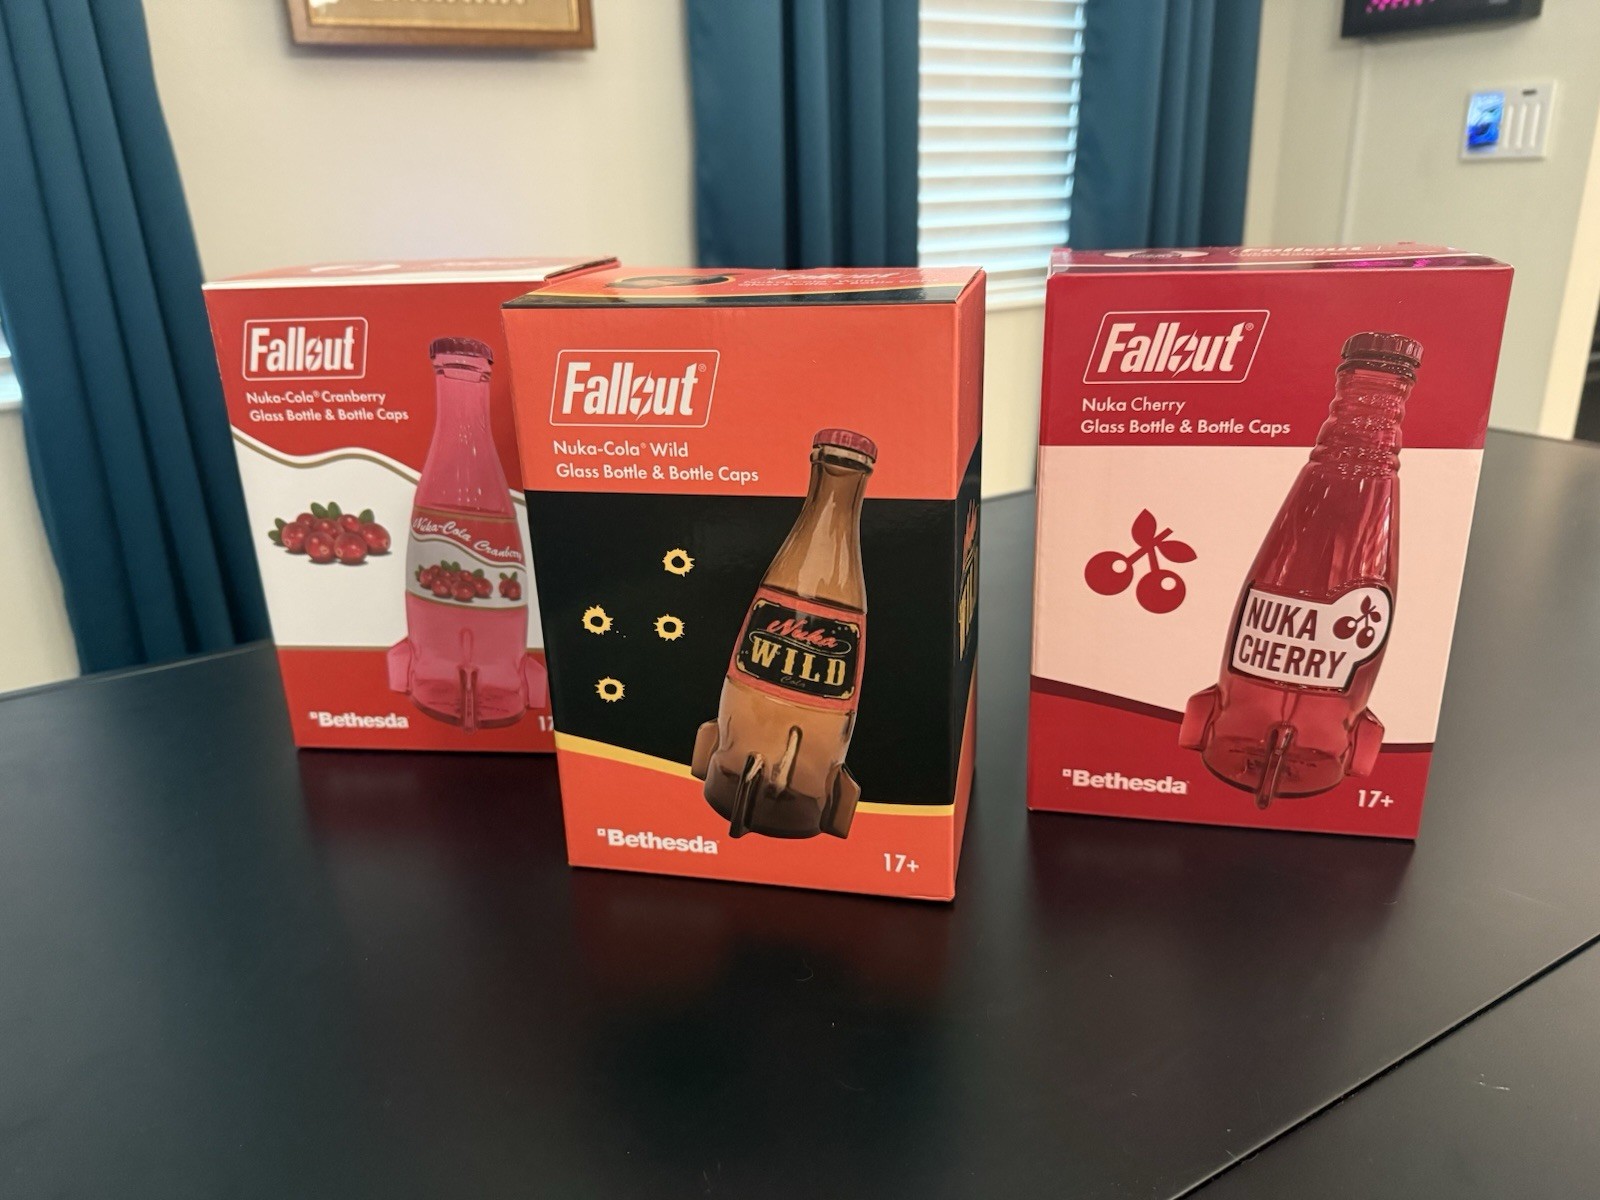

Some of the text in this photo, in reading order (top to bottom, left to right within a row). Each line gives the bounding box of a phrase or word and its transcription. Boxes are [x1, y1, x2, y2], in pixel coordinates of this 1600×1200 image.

[250, 326, 355, 373] Fallout
[321, 389, 386, 405] Cranberry
[1082, 396, 1186, 415] Nuka Cherry
[250, 408, 409, 423] Glass Bottle & Bottle Caps
[1080, 418, 1291, 438] Glass Bottle & Bottle Caps
[650, 442, 689, 458] Wild
[556, 463, 759, 485] Glass Bottle & Bottle Caps
[412, 517, 522, 561] Nuka-Cola Cranberry
[1245, 597, 1318, 641] NUKA
[766, 619, 838, 648] Nuka
[751, 635, 846, 686] WILD
[1238, 634, 1347, 679] CHERRY
[318, 712, 409, 729] Bethesda
[1072, 769, 1188, 795] Bethesda
[1357, 789, 1394, 808] 17+
[607, 829, 719, 854] Bethesda
[883, 853, 919, 873] 17+
